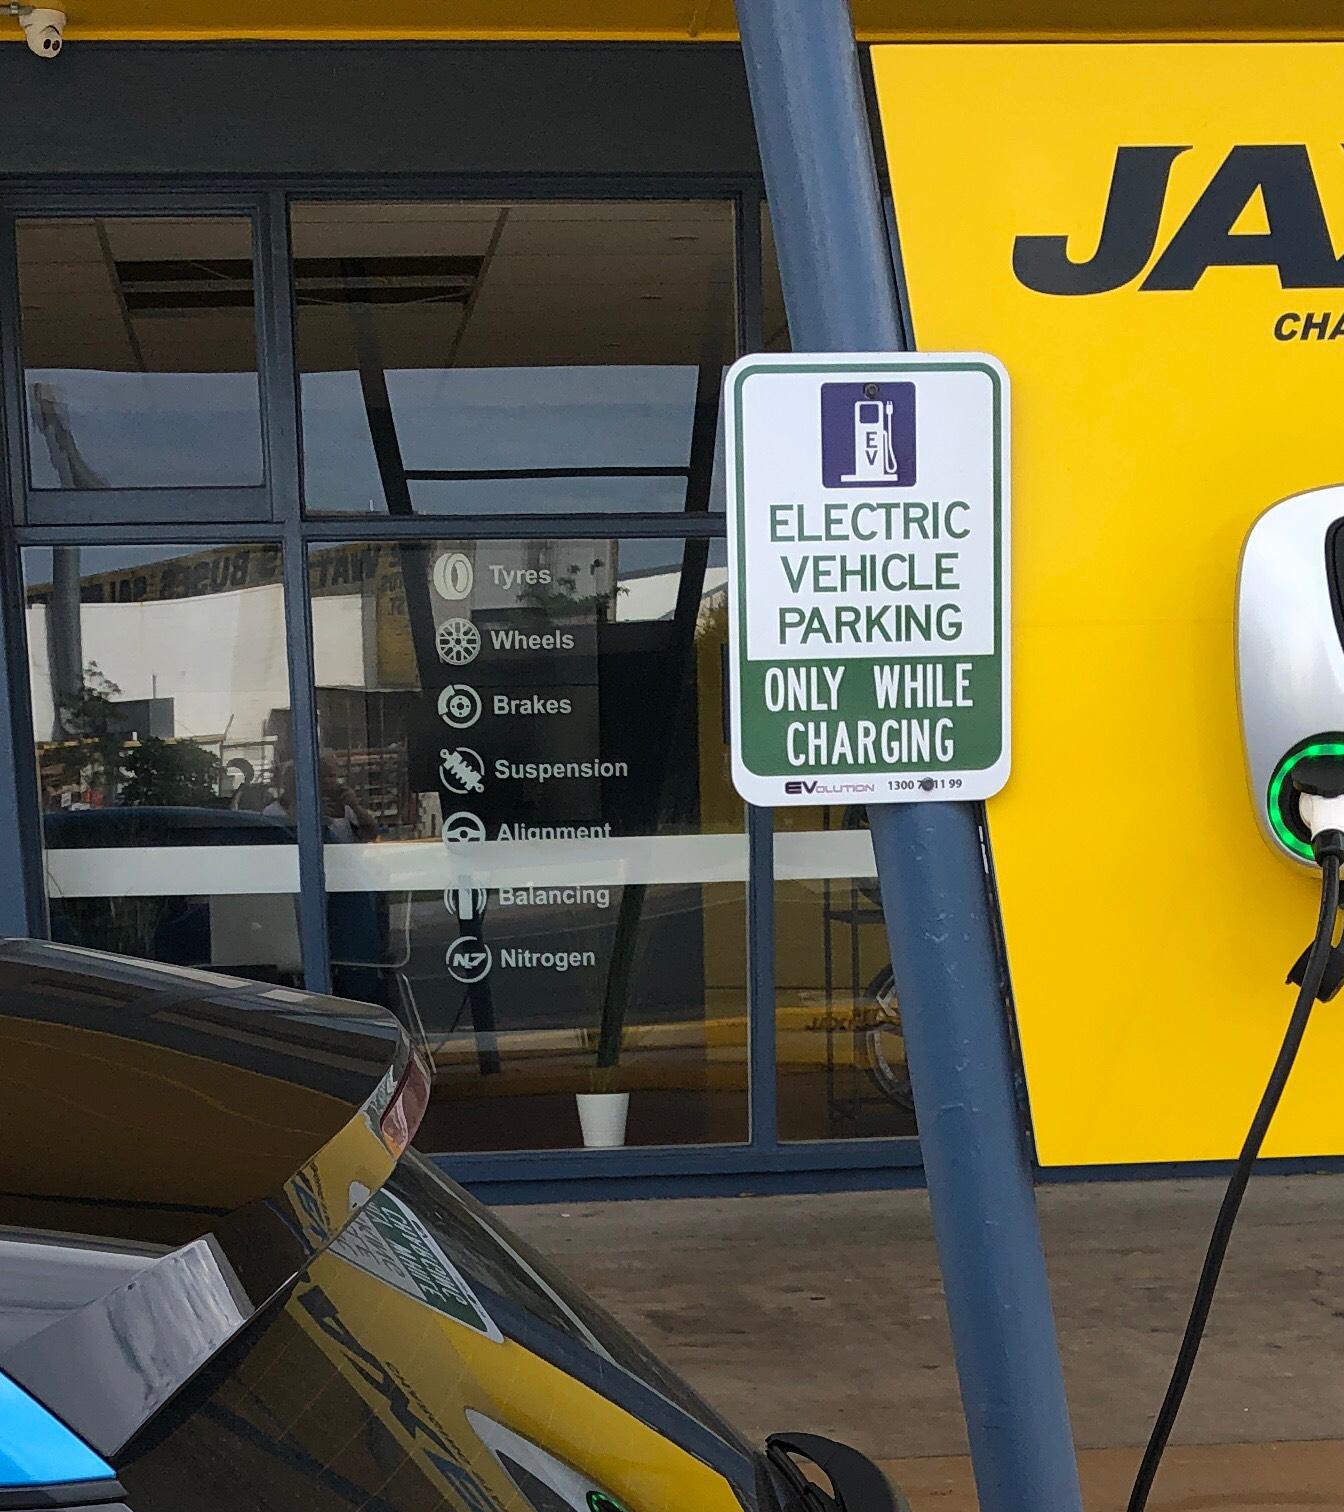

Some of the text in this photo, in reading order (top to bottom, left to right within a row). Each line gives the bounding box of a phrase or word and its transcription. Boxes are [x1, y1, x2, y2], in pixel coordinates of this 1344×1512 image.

[769, 500, 971, 542] ELECTRIC
[488, 564, 552, 590] Tyres
[779, 552, 960, 594] VEHICLE
[778, 603, 963, 645] PARKING
[490, 629, 575, 650] Wheels
[764, 662, 973, 713] ONLY WHILE
[492, 695, 572, 715] Brakes
[786, 718, 954, 767] CHARGING
[494, 759, 628, 782] Suspension
[887, 780, 914, 790] 1300
[948, 778, 963, 789] 99
[498, 885, 610, 909] Balancing
[500, 948, 596, 972] Nitrogen
